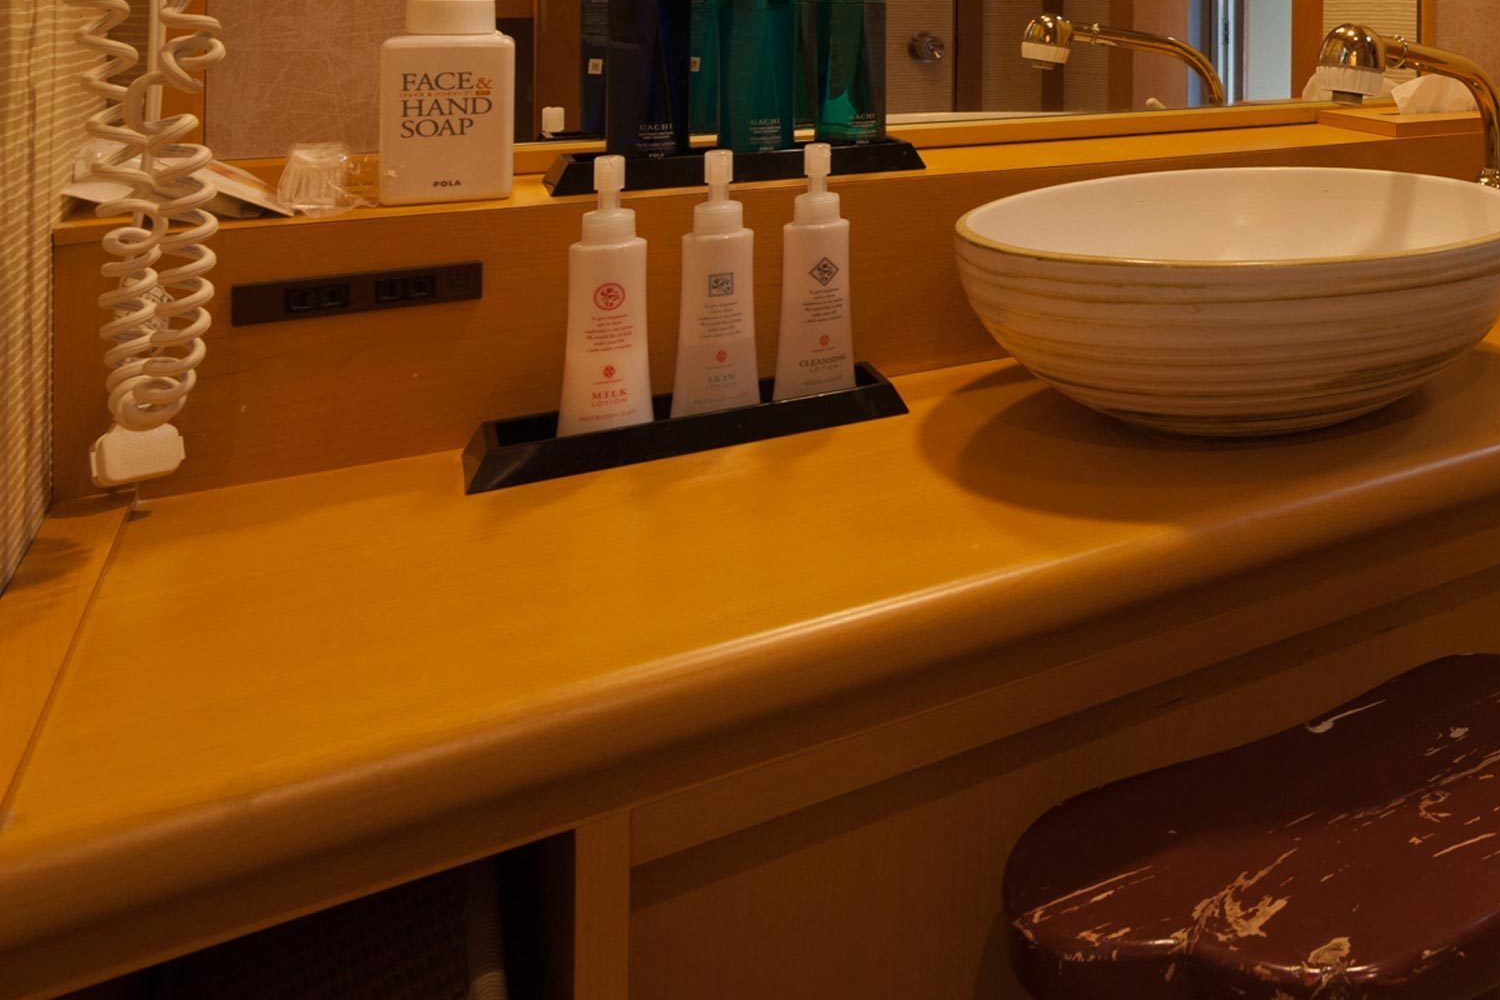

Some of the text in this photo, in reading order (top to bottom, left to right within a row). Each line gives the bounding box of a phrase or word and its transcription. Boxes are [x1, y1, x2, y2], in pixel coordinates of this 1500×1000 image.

[402, 72, 492, 91] FACE &
[401, 97, 493, 118] HAND
[400, 118, 474, 139] SOAP
[433, 180, 462, 188] POLA
[592, 388, 627, 400] MILK
